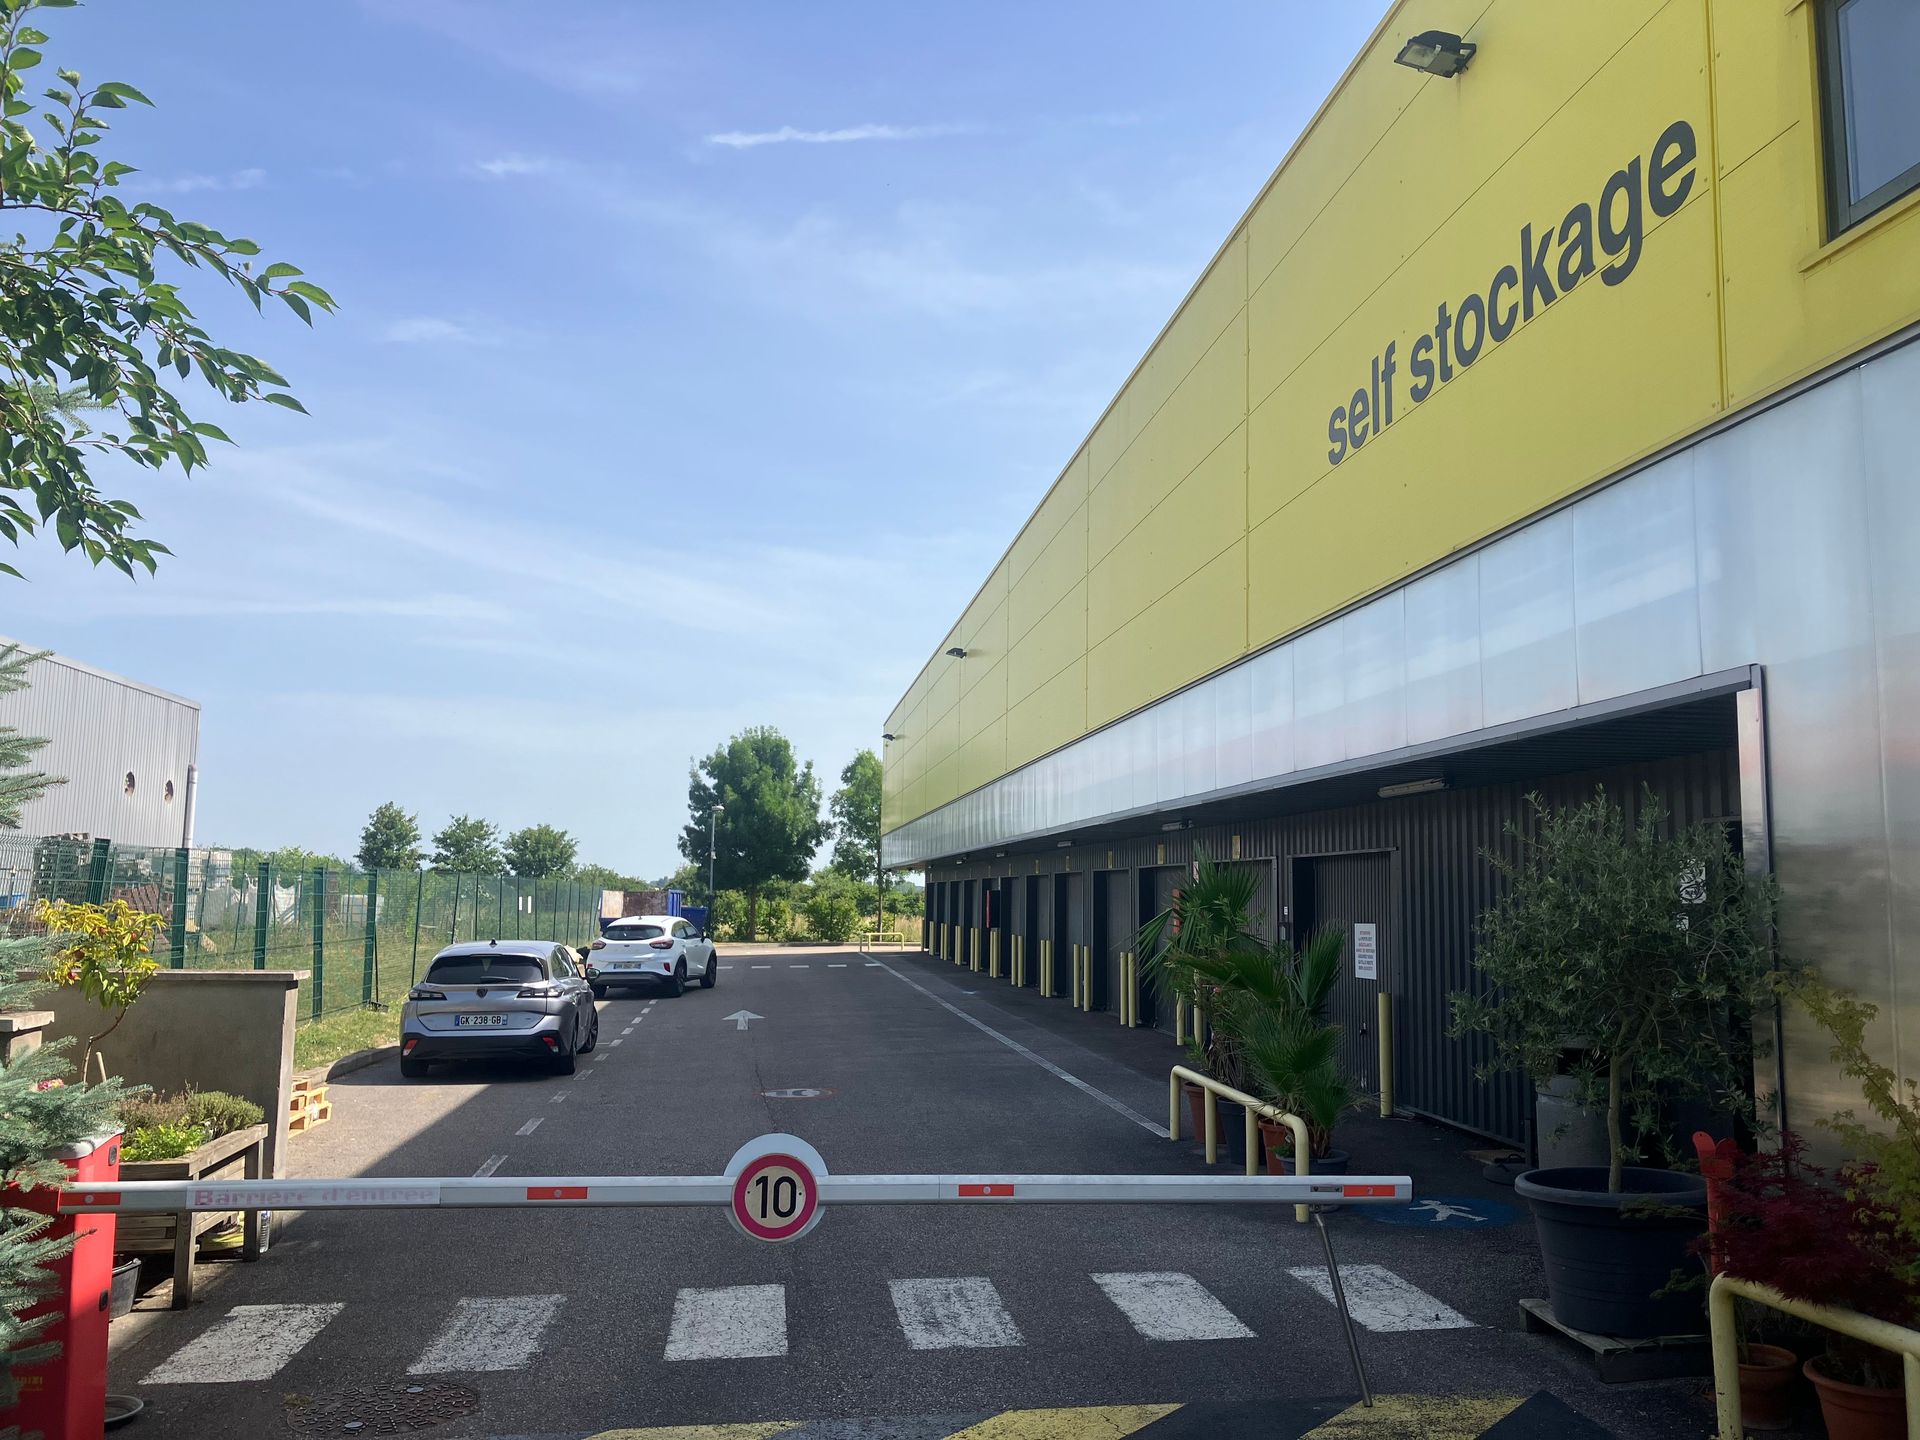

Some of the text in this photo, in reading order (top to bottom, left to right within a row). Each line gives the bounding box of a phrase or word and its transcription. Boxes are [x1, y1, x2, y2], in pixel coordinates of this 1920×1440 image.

[1327, 120, 1697, 466] self stockage
[460, 1015, 502, 1025] GK-238-GB
[755, 1175, 797, 1219] 10
